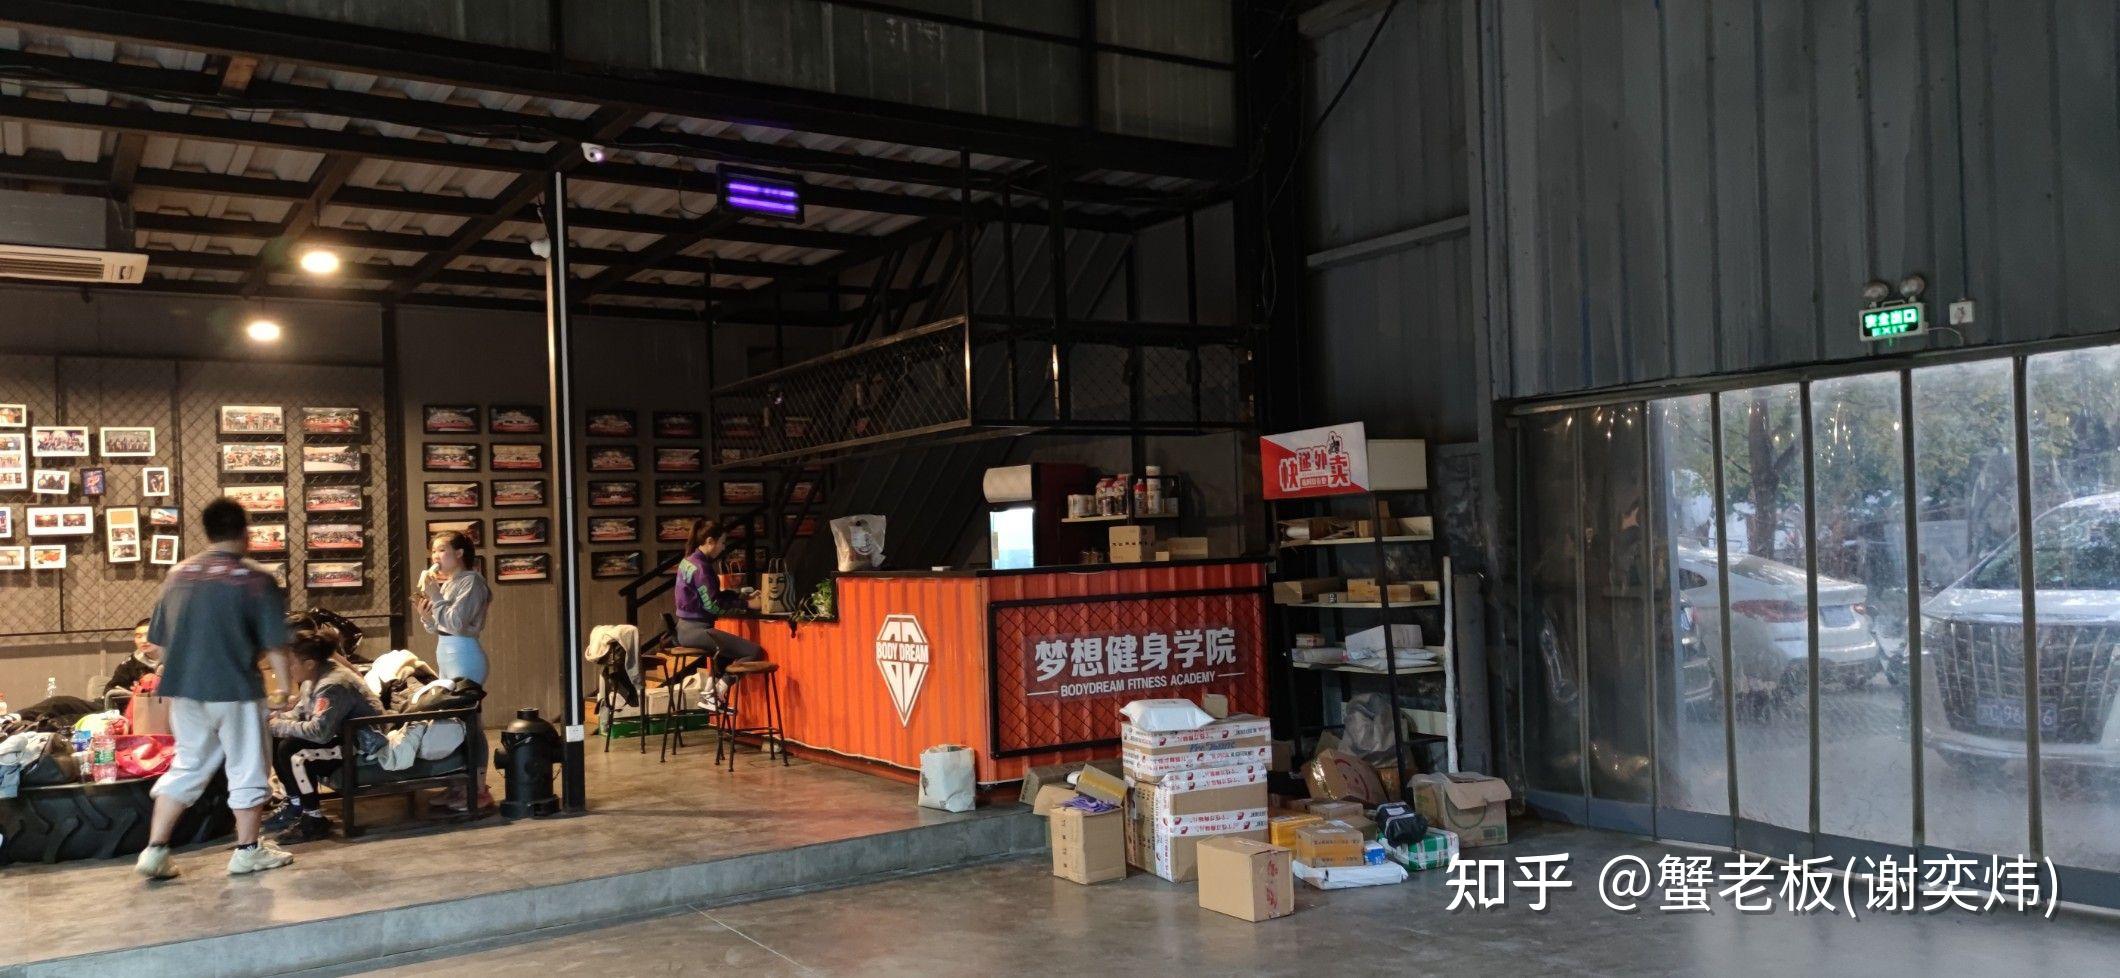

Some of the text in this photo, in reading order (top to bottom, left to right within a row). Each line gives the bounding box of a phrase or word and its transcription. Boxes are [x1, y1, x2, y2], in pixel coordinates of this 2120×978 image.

[1865, 309, 1917, 328] 安全出口
[1872, 325, 1908, 336] EXIT
[1280, 451, 1348, 489] 快递外卖
[876, 642, 928, 663] BODY DREAM
[1035, 627, 1237, 682] 梦想健身学院
[1061, 671, 1216, 697] BODYDREAM FITNESS ACADEMY
